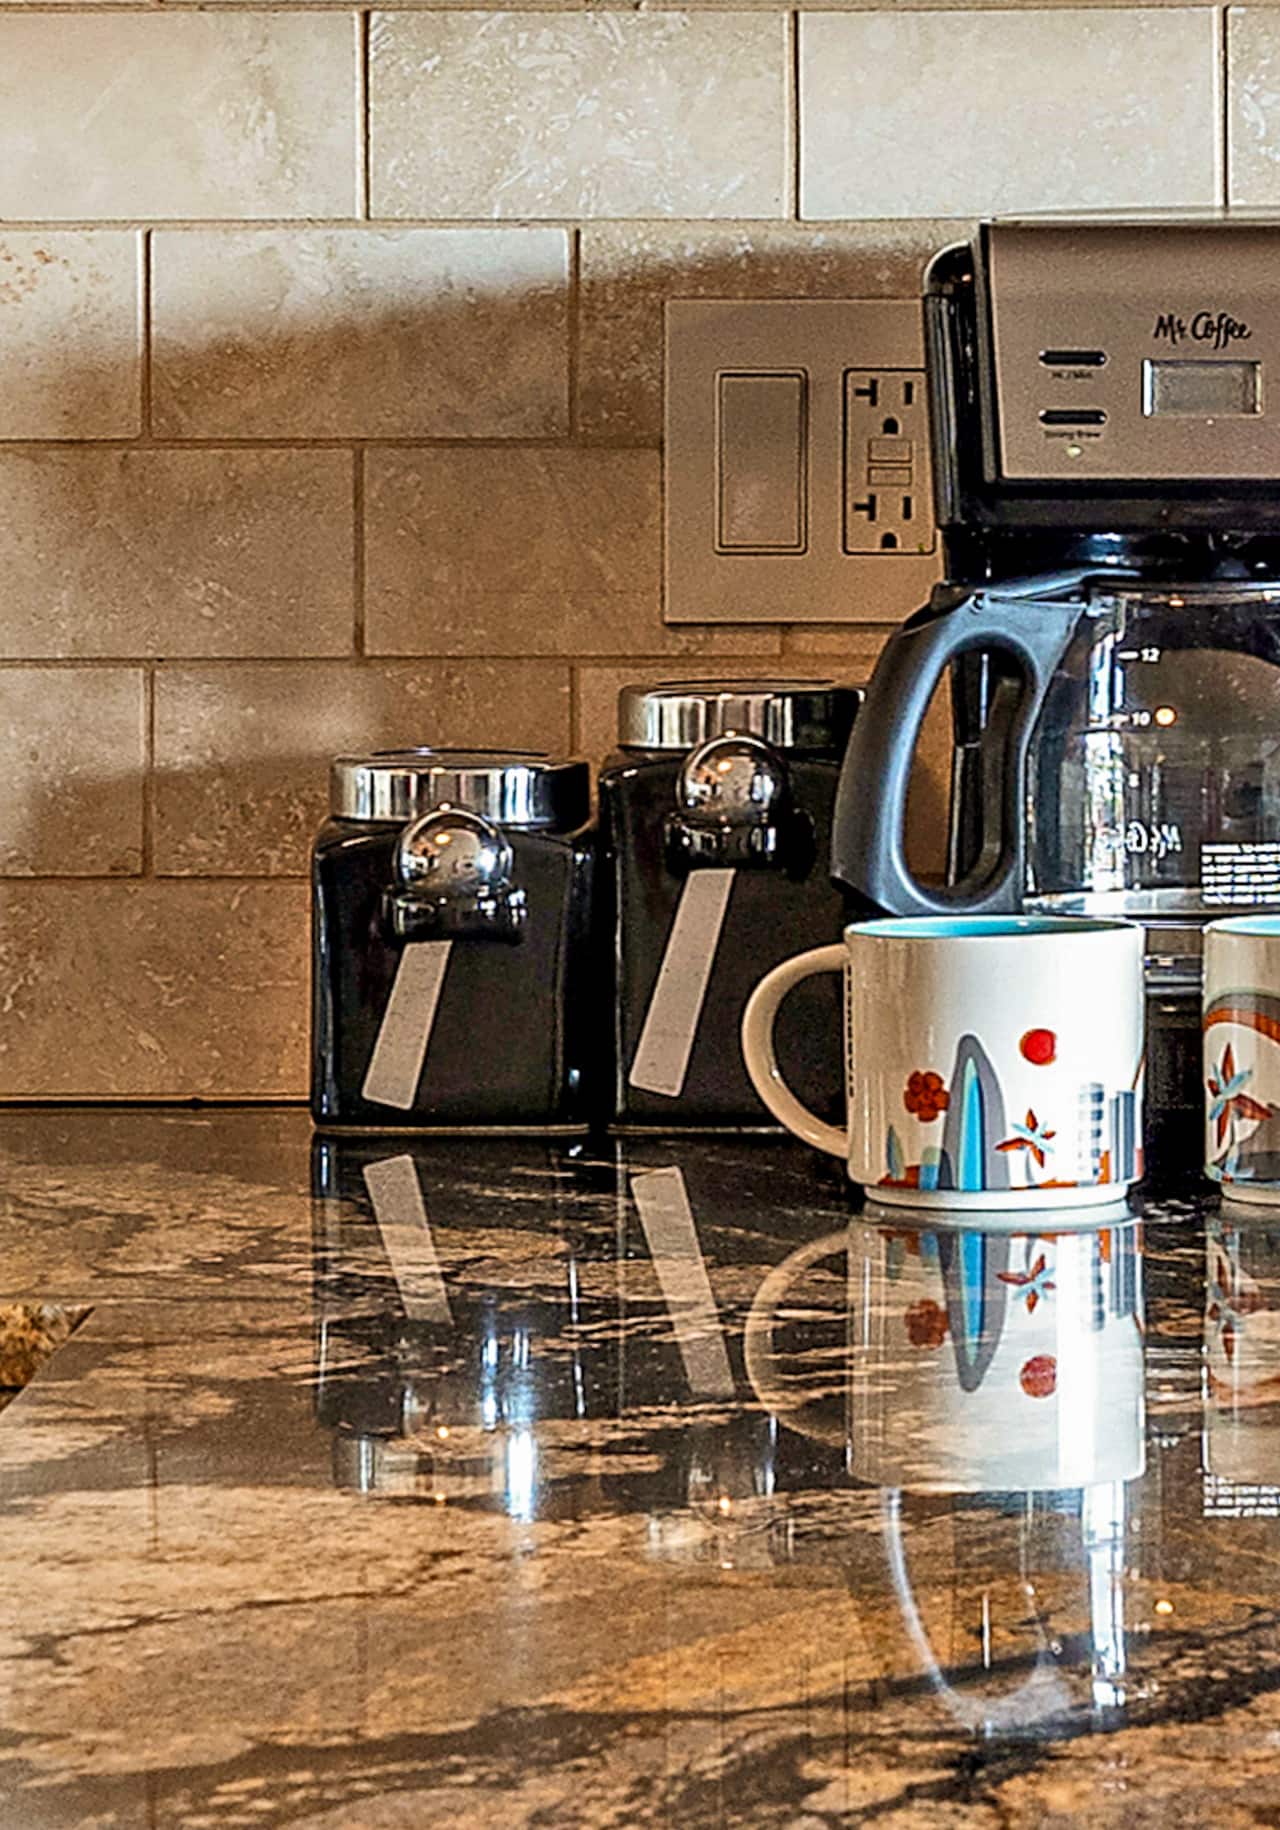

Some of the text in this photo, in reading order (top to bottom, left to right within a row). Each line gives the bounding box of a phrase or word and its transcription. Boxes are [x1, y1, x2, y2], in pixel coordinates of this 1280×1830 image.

[1191, 311, 1253, 350] Coffee
[1141, 648, 1160, 662] 12
[1131, 711, 1150, 726] 10
